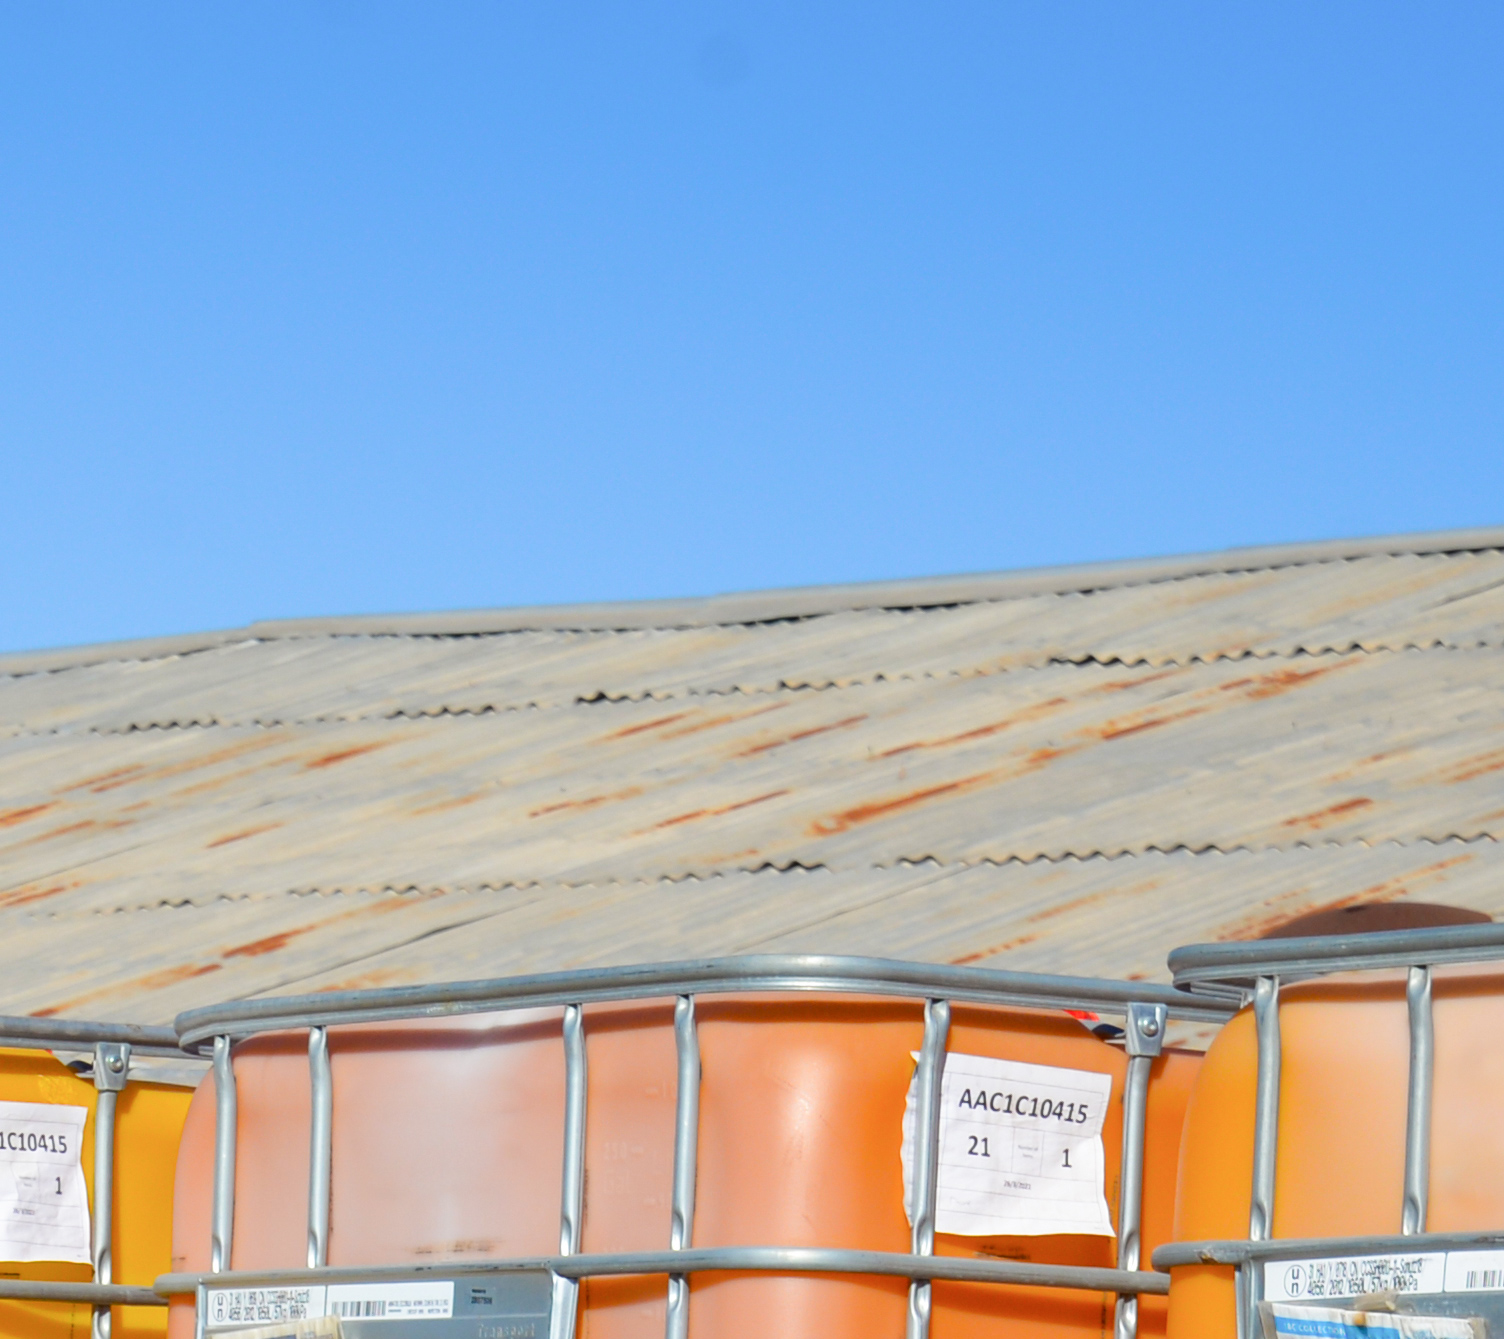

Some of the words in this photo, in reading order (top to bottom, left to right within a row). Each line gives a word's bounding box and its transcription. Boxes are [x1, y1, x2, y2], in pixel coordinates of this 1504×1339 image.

[959, 1088, 1088, 1124] AAC1C10415
[967, 1136, 991, 1157] 21
[1062, 1149, 1072, 1168] 1
[55, 1177, 62, 1195] 1
[477, 1323, 536, 1339] Transport
